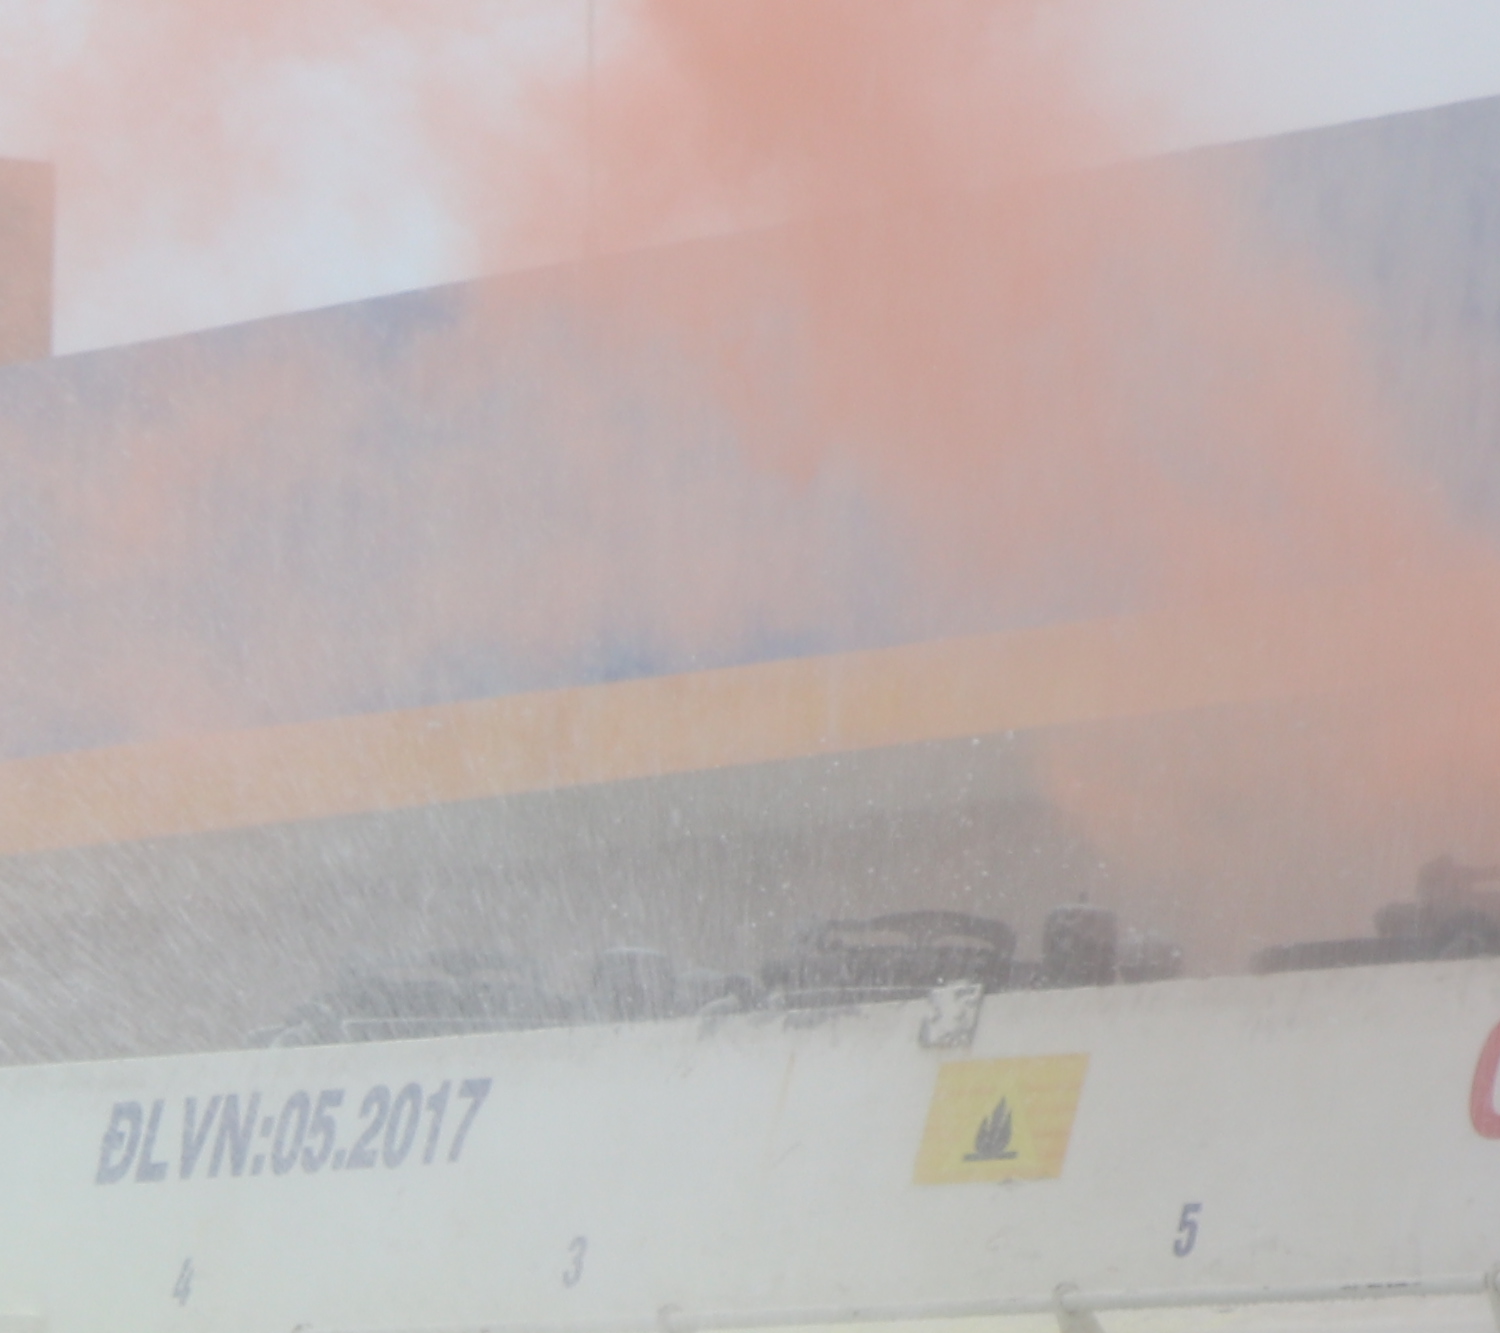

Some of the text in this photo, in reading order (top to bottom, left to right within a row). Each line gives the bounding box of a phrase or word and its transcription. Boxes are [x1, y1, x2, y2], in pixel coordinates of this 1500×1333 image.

[95, 1077, 493, 1186] ĐLVN:05.2017
[1172, 1203, 1202, 1259] 5
[561, 1236, 588, 1289] 3
